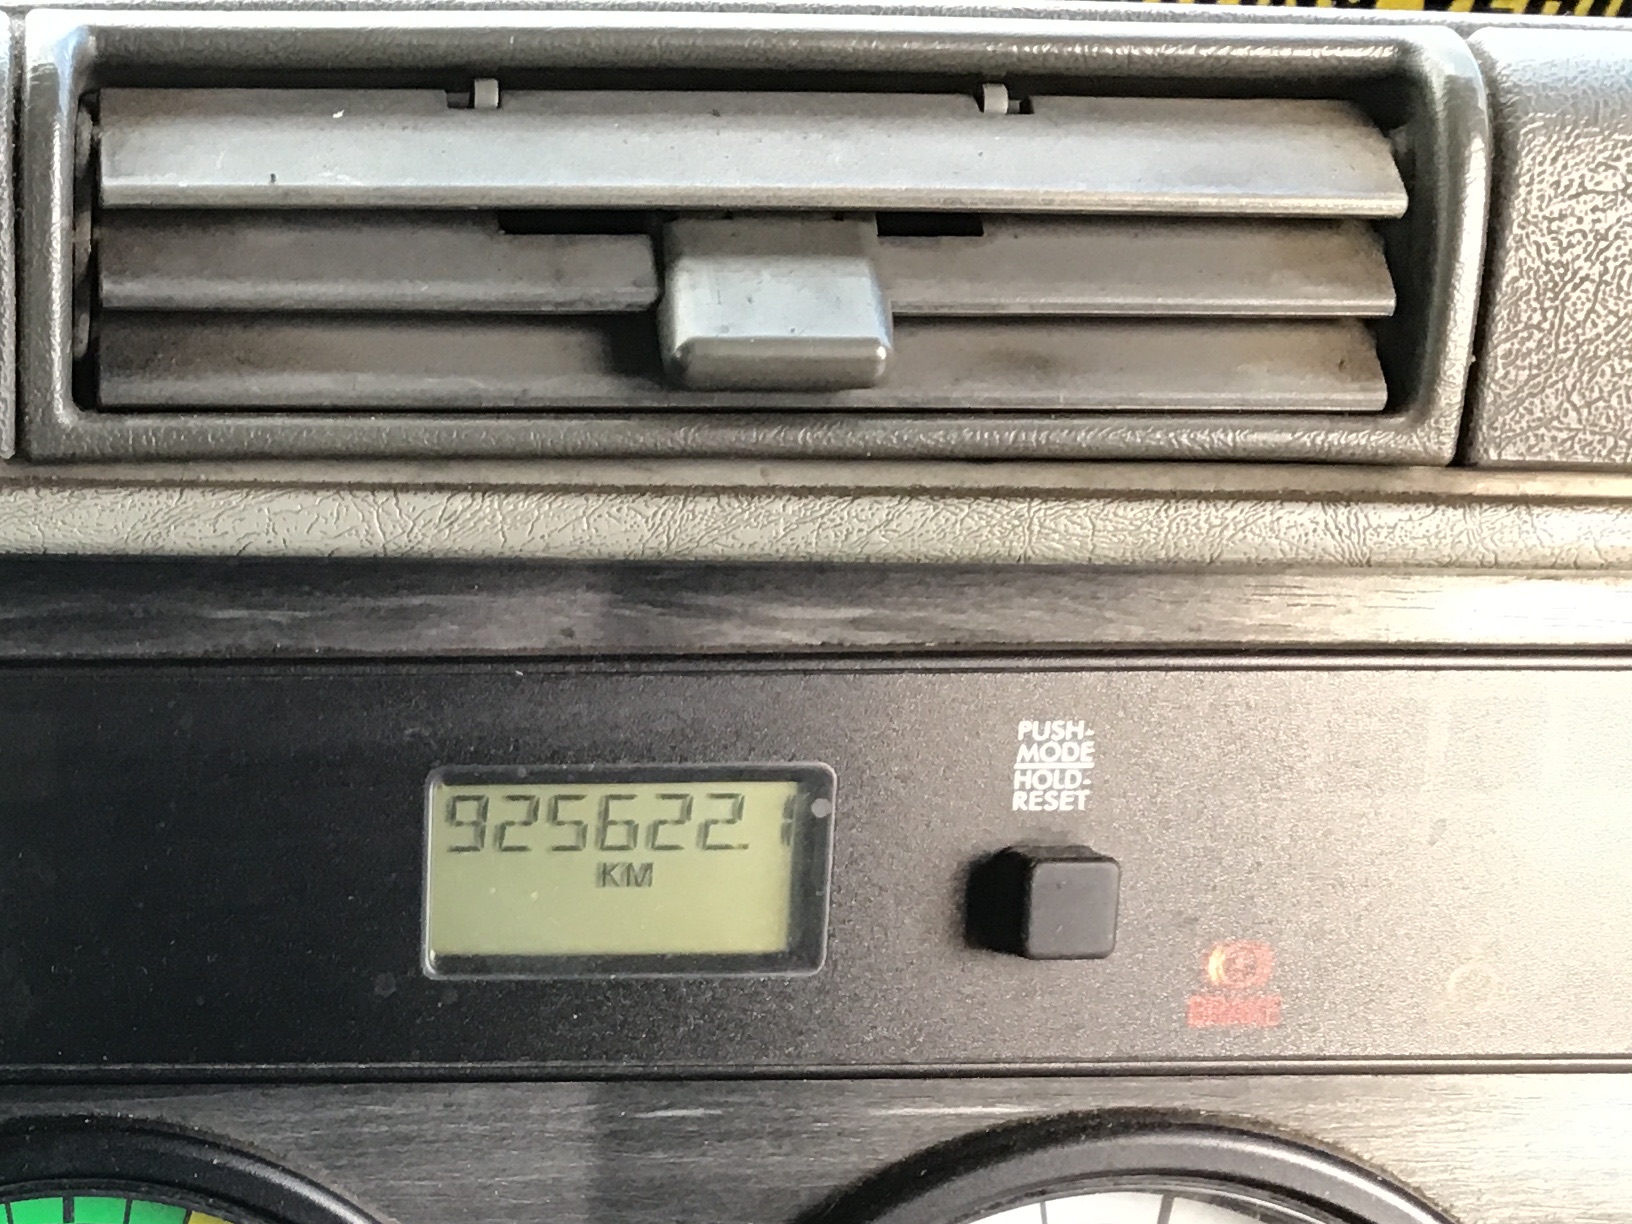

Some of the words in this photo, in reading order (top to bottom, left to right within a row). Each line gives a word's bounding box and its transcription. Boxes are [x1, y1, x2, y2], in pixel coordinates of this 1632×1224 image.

[1018, 720, 1095, 741] PUSH-
[1016, 741, 1095, 763] MODE
[1014, 769, 1091, 790] HOLD-
[1012, 790, 1090, 811] RESET
[597, 862, 654, 889] KM
